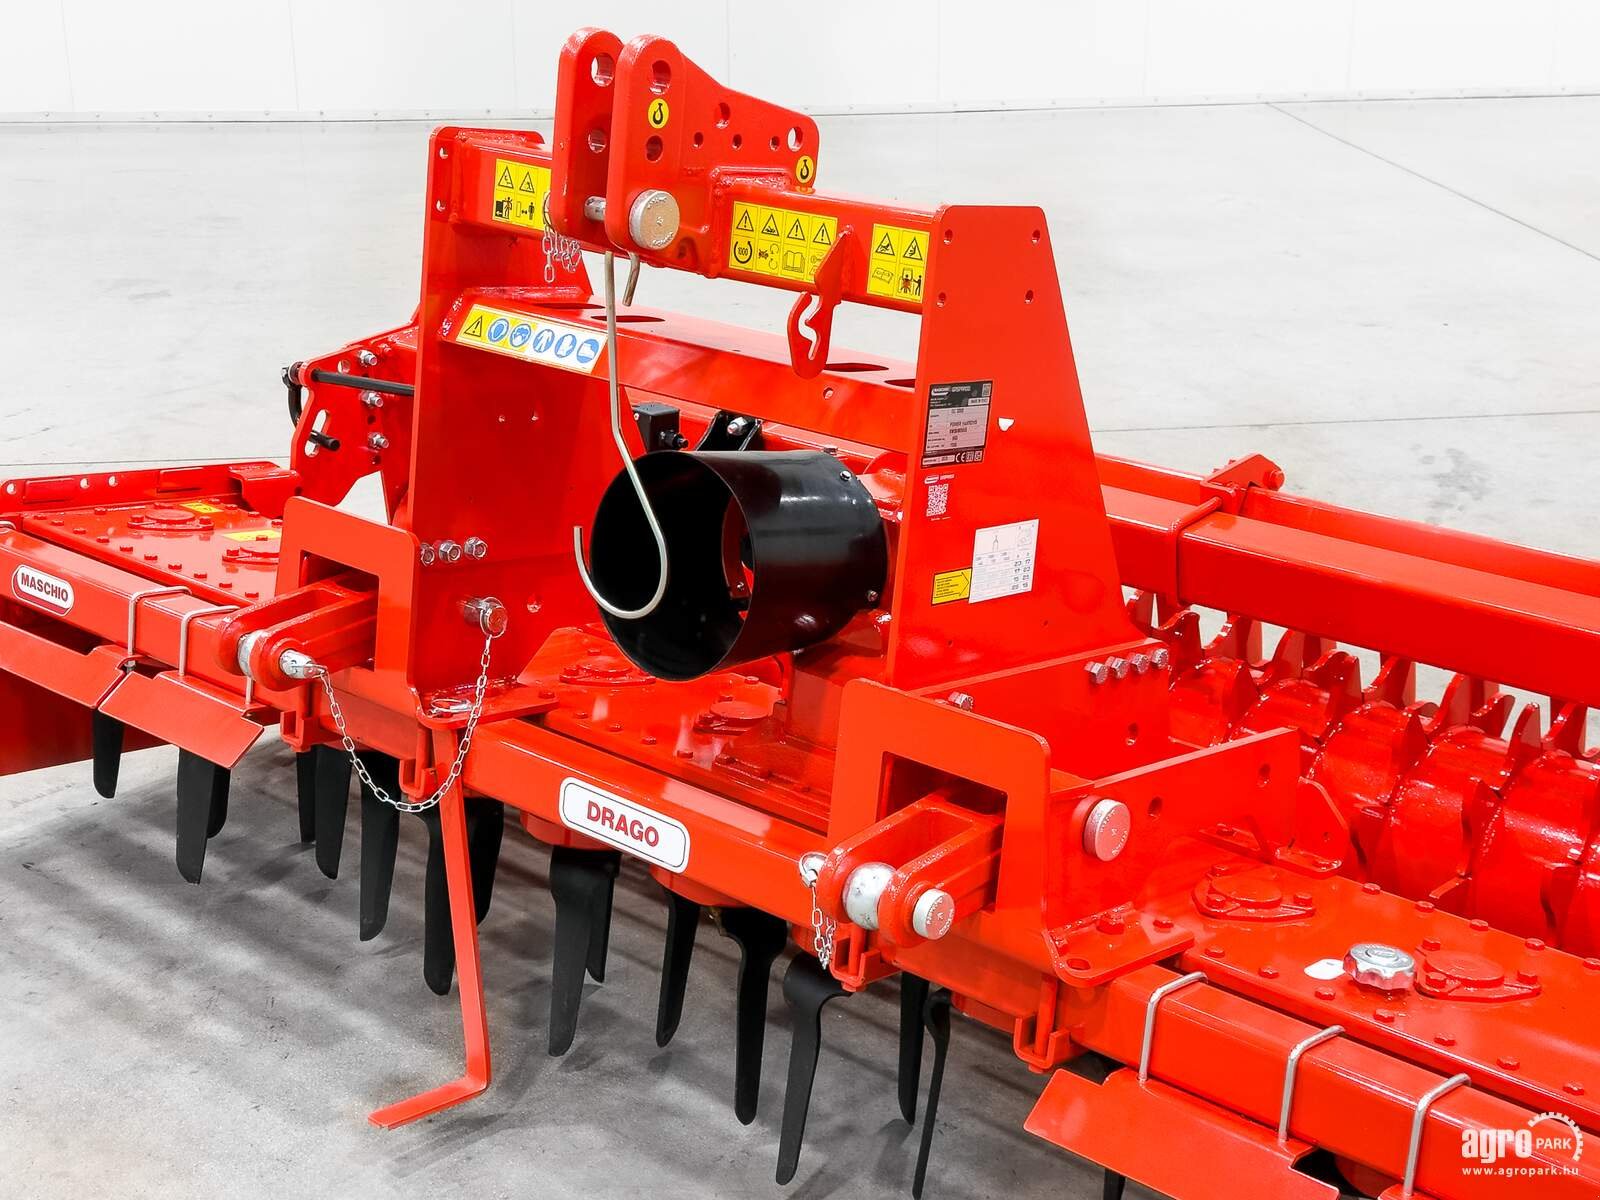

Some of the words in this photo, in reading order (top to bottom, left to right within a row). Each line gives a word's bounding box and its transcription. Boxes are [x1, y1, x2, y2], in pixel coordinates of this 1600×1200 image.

[738, 246, 748, 256] 1000
[21, 572, 68, 602] MASCHIO
[587, 800, 660, 848] DRAGO
